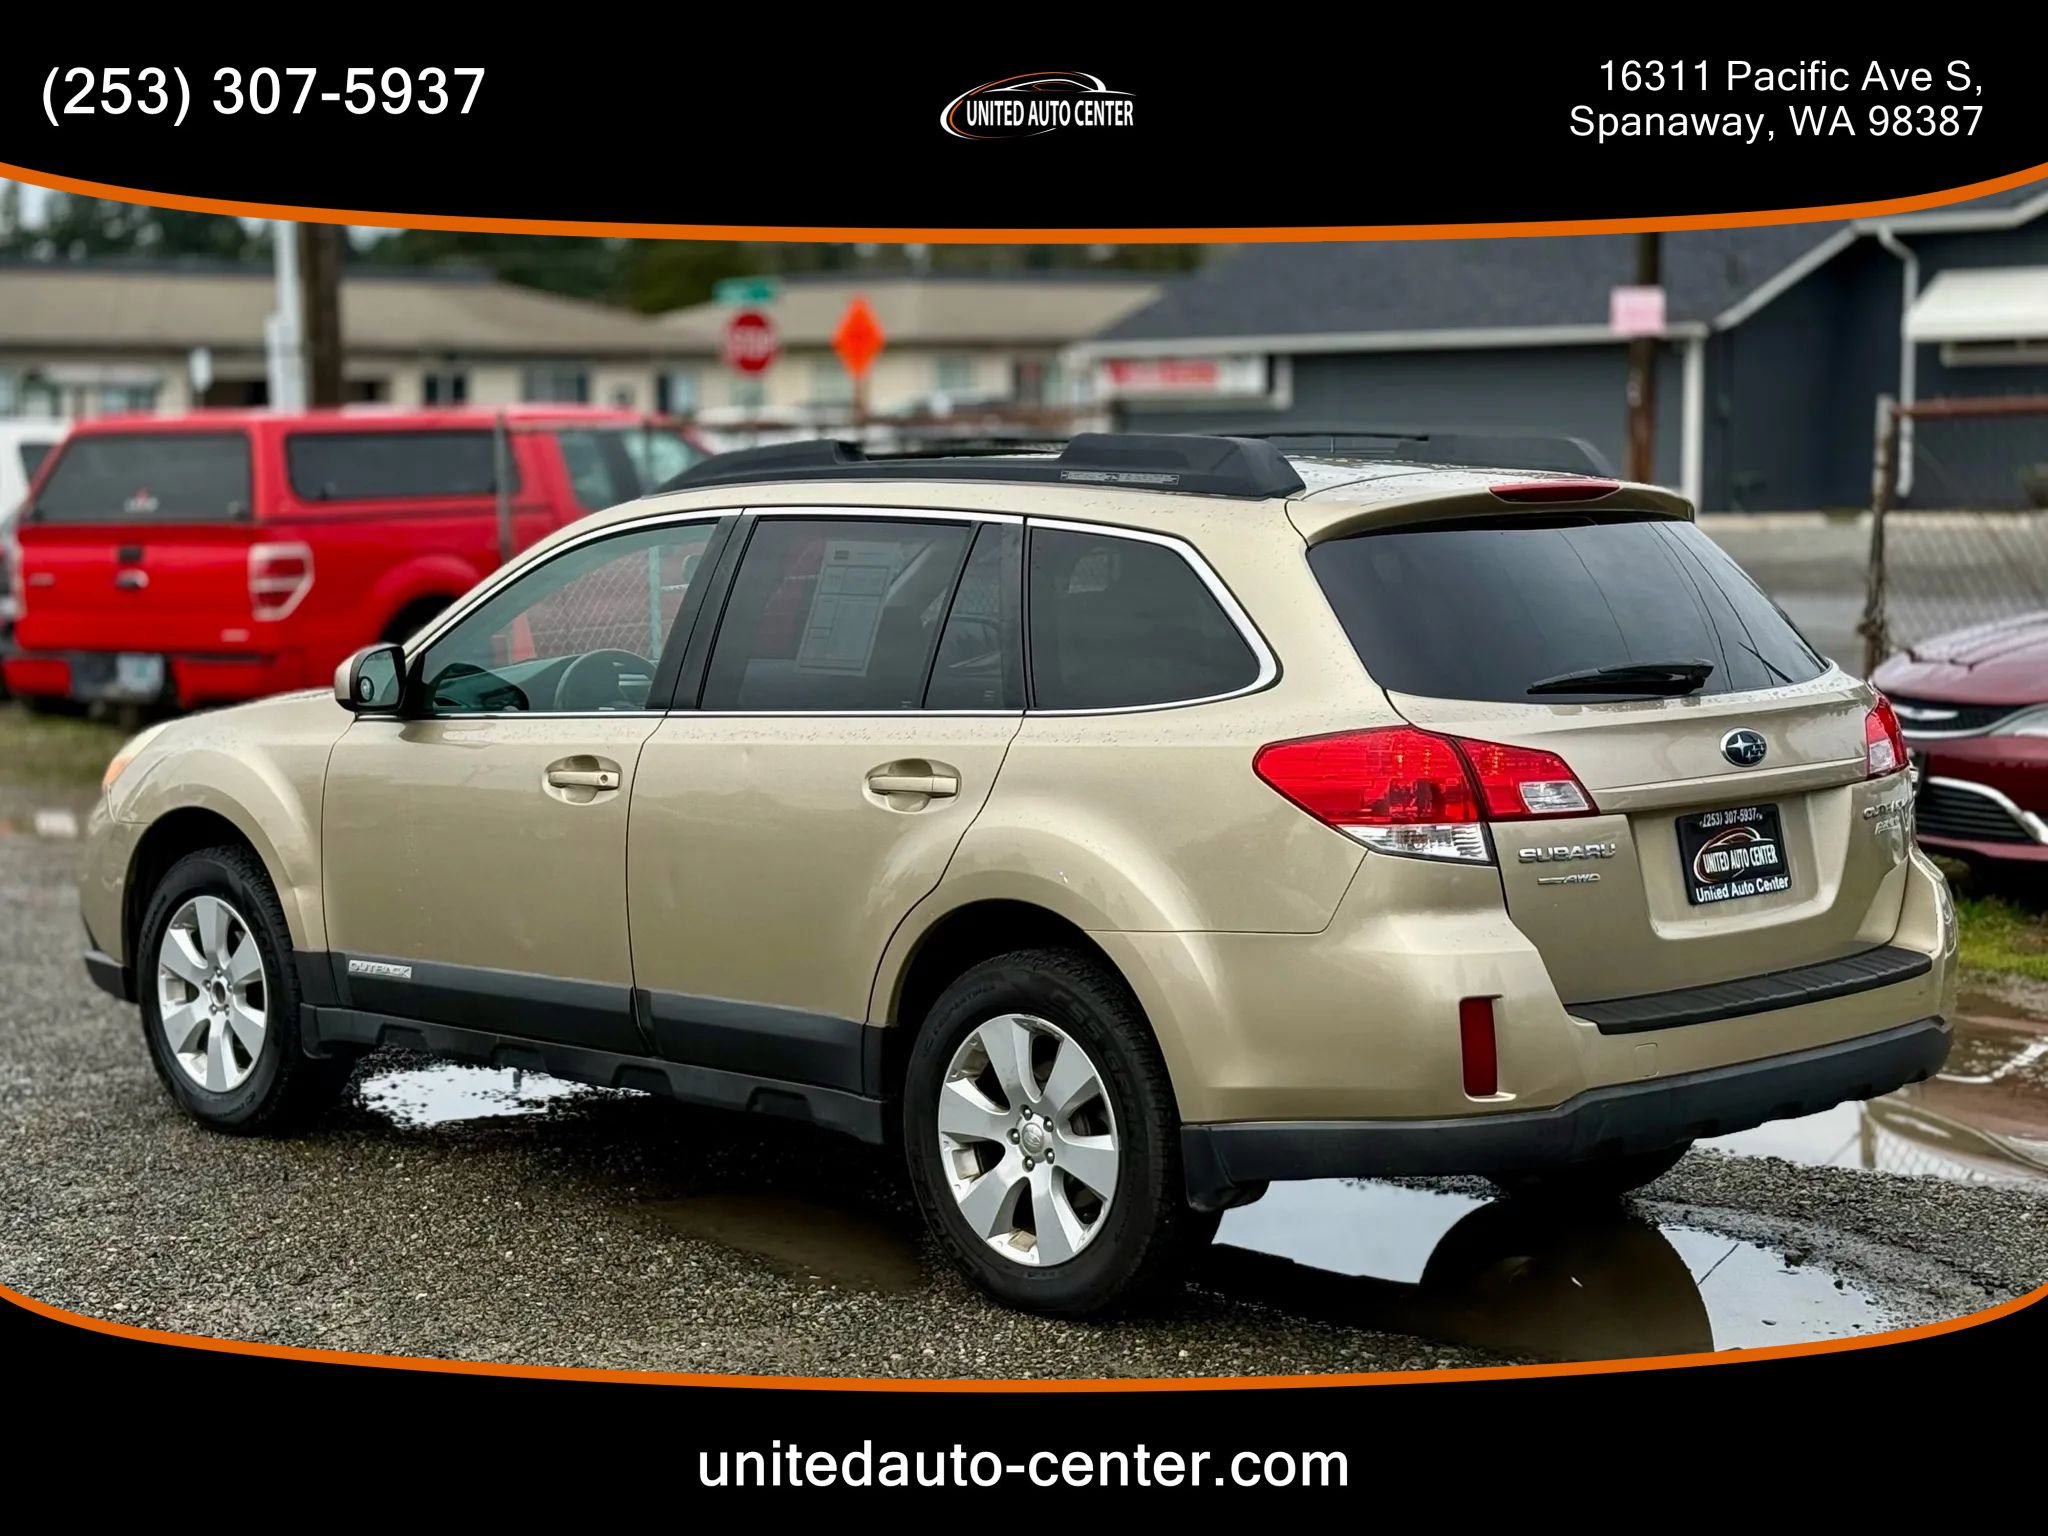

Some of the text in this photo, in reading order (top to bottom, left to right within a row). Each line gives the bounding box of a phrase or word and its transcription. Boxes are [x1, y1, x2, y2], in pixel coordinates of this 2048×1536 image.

[1518, 843, 1617, 863] SUBARU
[1702, 844, 1778, 874] UNITED AUTO CENTER
[1696, 876, 1789, 903] United Auto Center
[349, 960, 412, 979] OUTBACK
